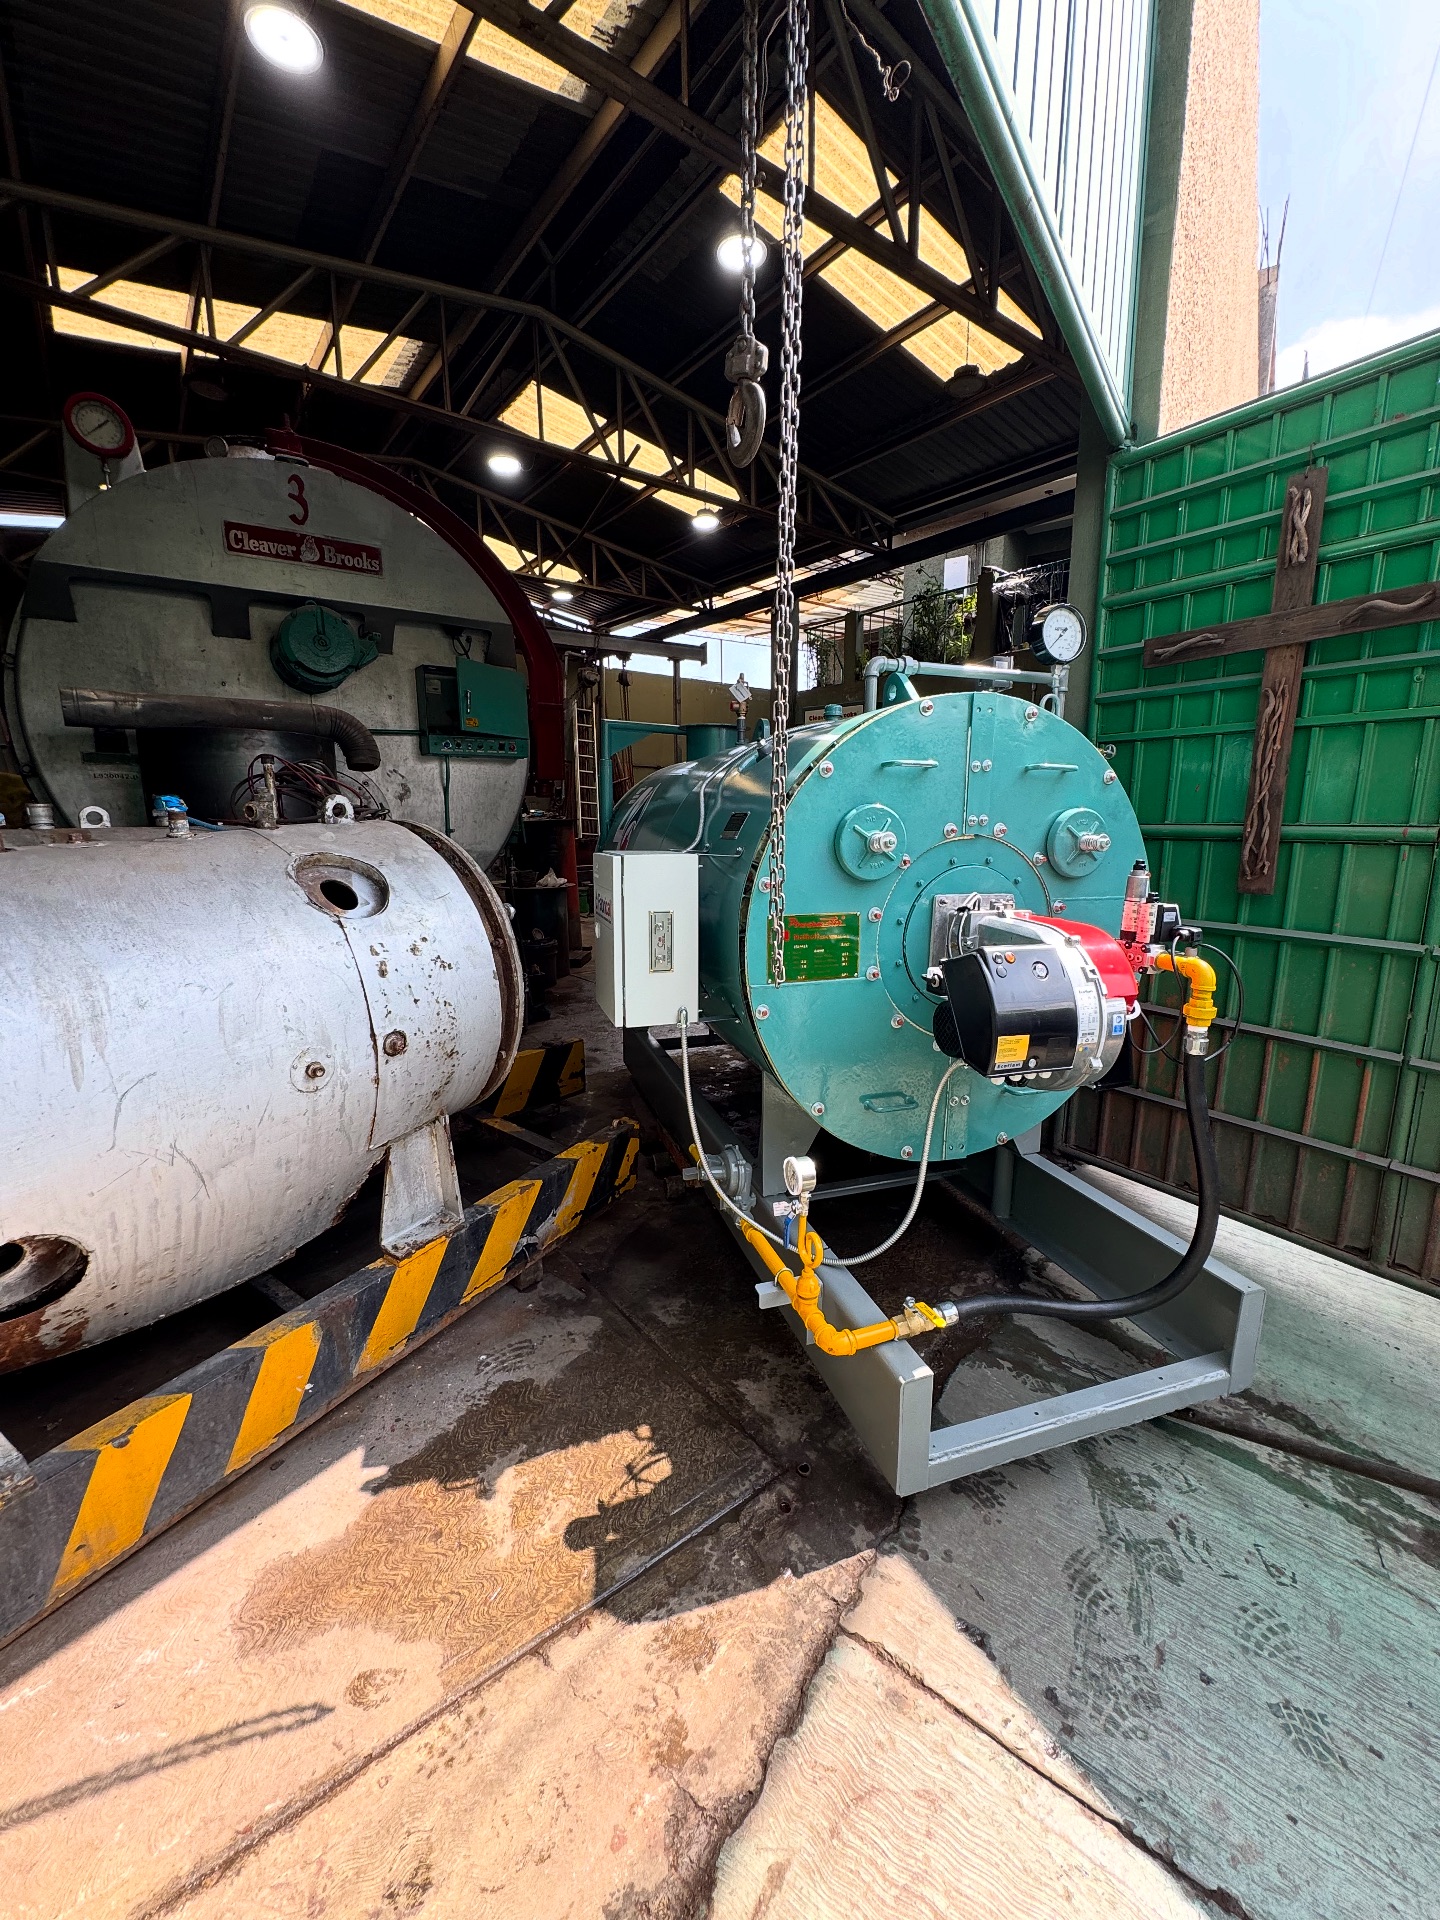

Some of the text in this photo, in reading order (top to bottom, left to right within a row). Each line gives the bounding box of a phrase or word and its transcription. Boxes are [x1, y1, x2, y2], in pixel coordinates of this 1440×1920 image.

[288, 474, 309, 526] 3
[228, 529, 380, 572] Cleaver Brooks
